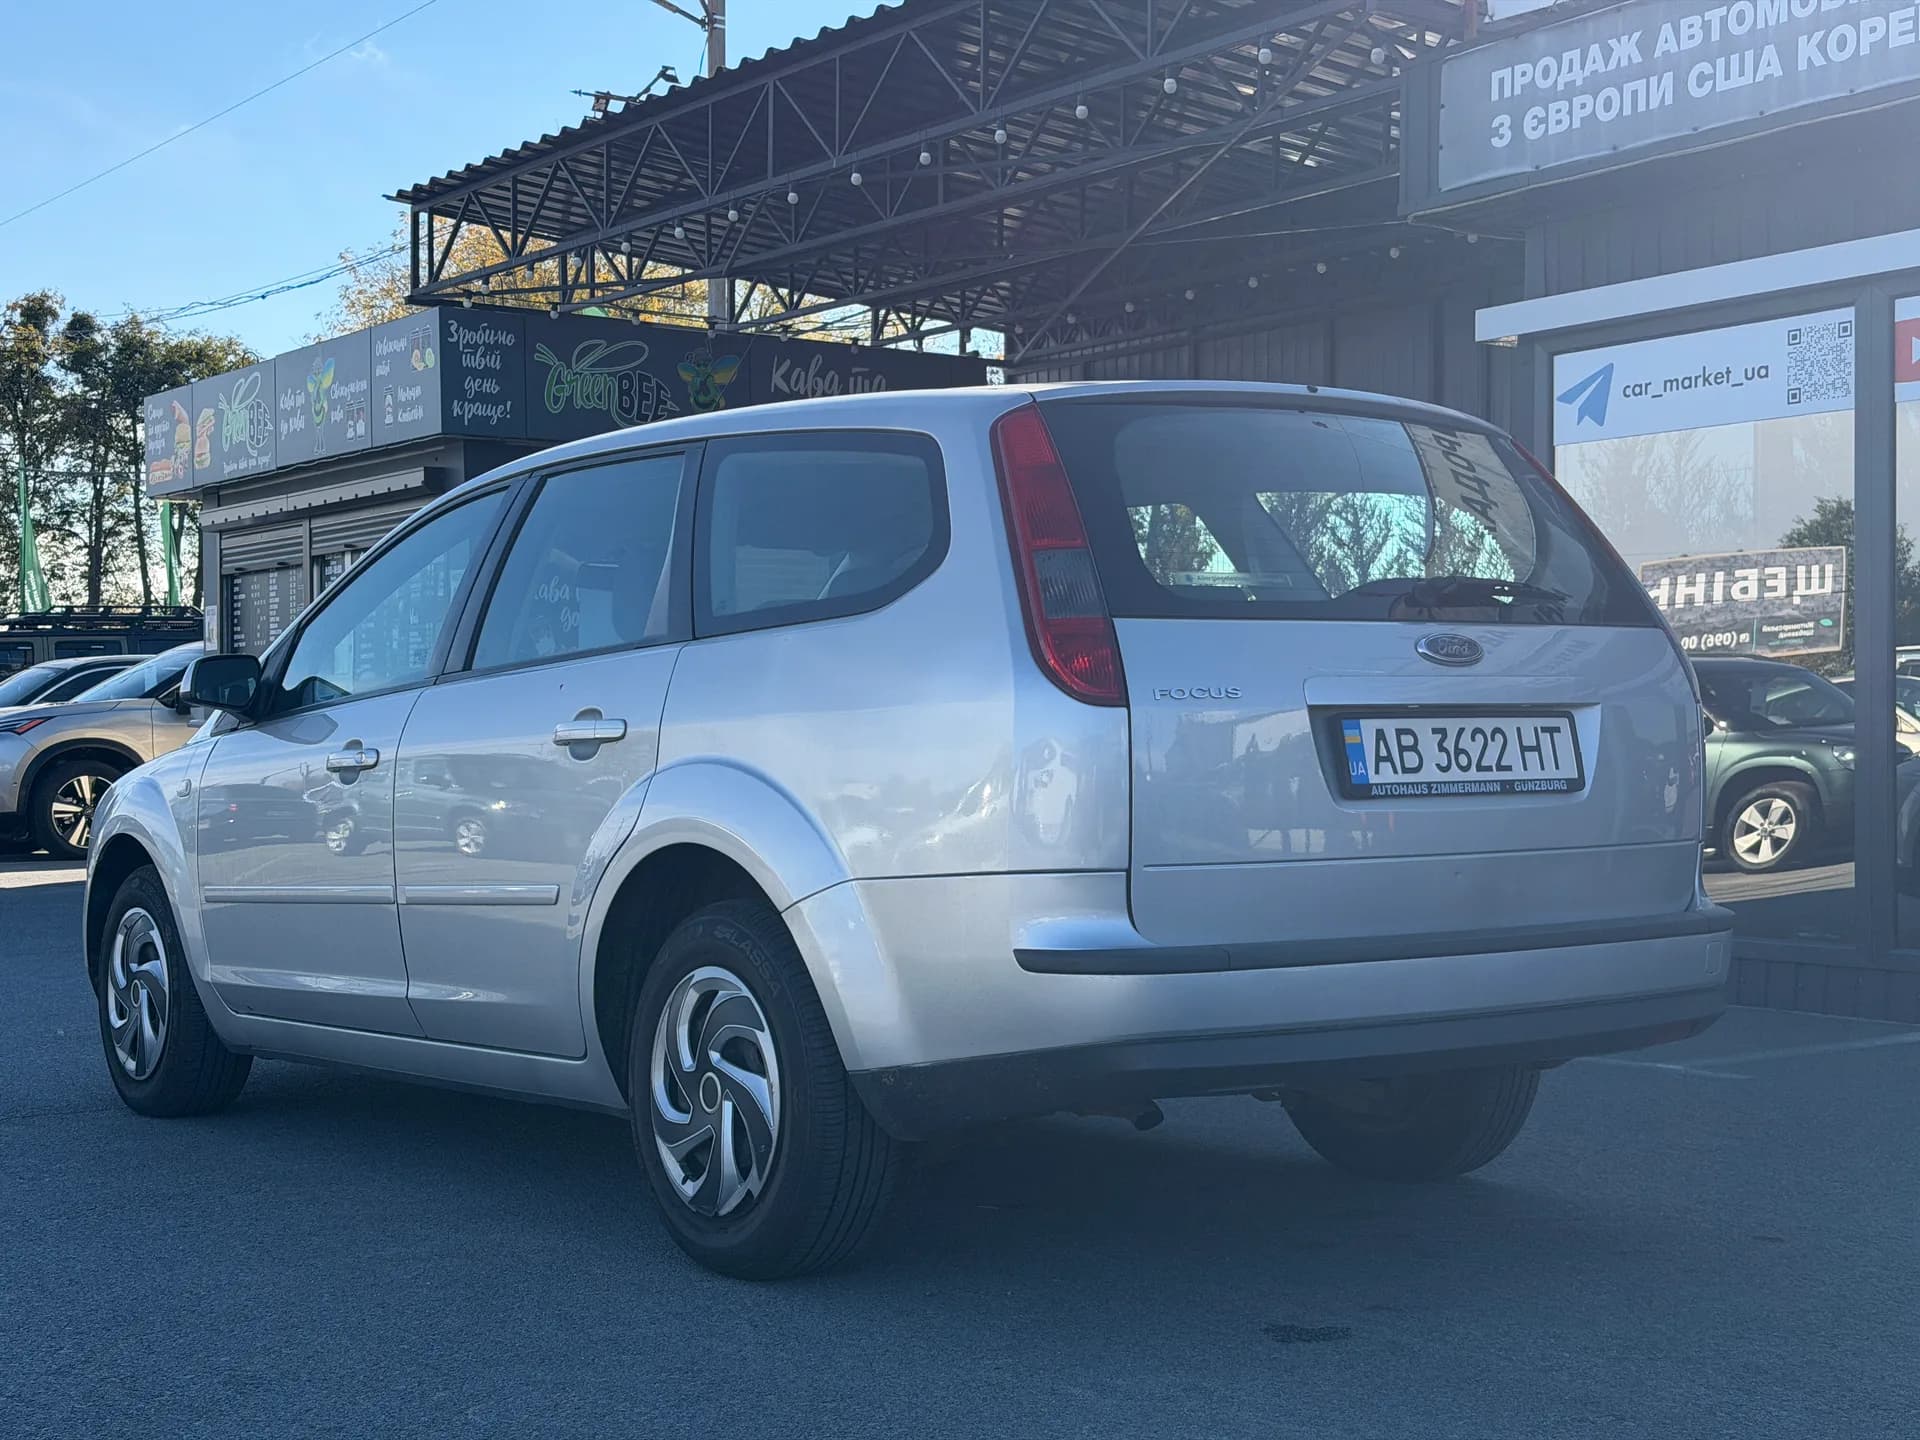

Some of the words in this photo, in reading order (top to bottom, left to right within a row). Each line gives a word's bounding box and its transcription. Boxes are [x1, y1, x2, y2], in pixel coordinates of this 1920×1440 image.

[1490, 30, 1643, 102] ПРОДАЖ
[1653, 0, 1864, 58] АВТОМО
[1490, 114, 1512, 148] З
[1522, 73, 1674, 140] ЄВРОПИ
[1687, 44, 1784, 98] США
[1797, 5, 1920, 72] КОРЕ
[447, 319, 515, 351] Зробимо
[461, 346, 502, 370] твій
[464, 374, 501, 399] день
[770, 354, 843, 398] Кава
[1622, 365, 1770, 398] car_market_ua
[451, 400, 511, 425] краще!
[535, 576, 570, 603] ава
[1152, 686, 1243, 701] FOCUS
[1431, 727, 1513, 774] 3622
[1515, 726, 1562, 772] HT
[1350, 761, 1368, 777] UA
[1371, 782, 1429, 797] AUTOHAUS
[1430, 780, 1501, 795] ZIMMERMANN
